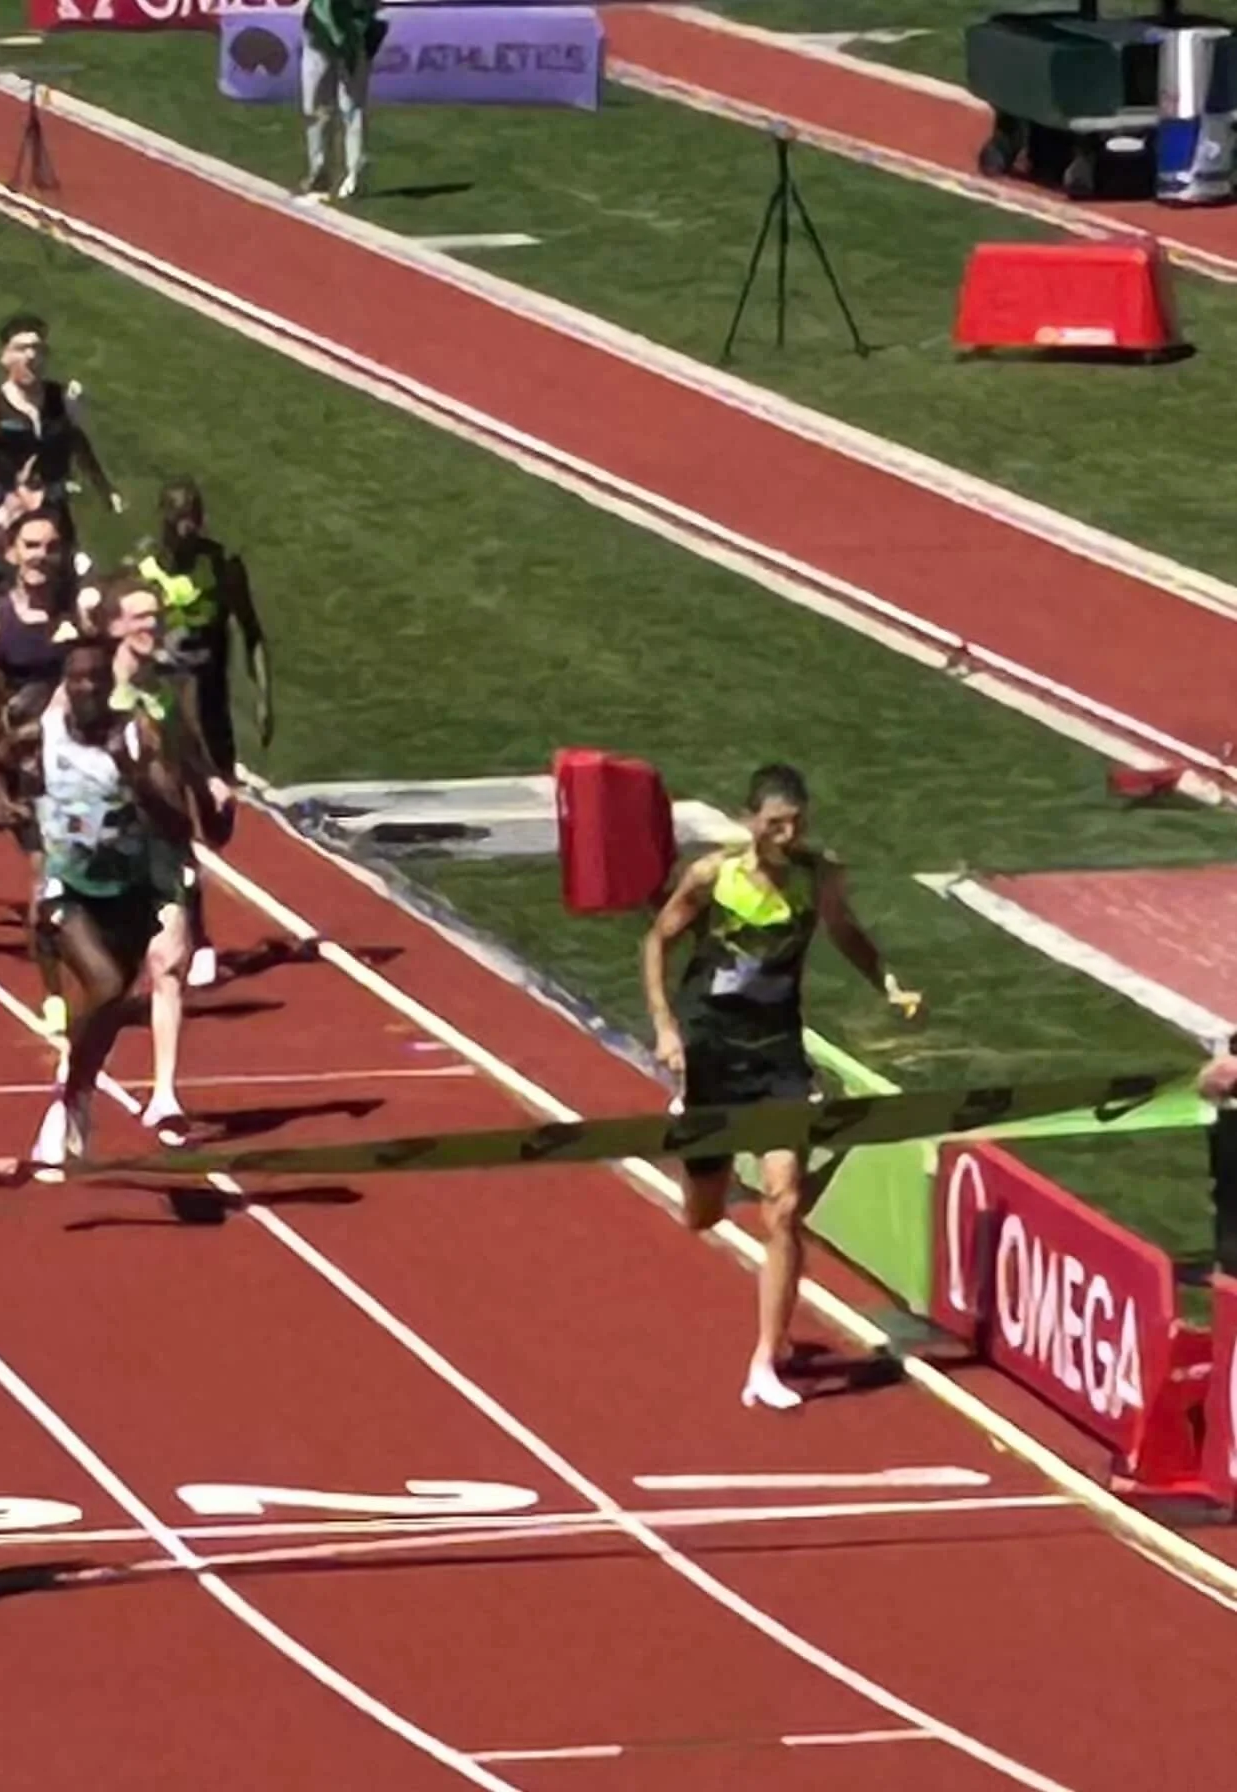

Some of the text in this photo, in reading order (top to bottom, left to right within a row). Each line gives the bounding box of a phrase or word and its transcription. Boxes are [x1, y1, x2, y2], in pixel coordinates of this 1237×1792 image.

[416, 42, 587, 73] ATHLETICS
[996, 1213, 1143, 1419] OMEGA
[176, 1479, 540, 1515] 2
